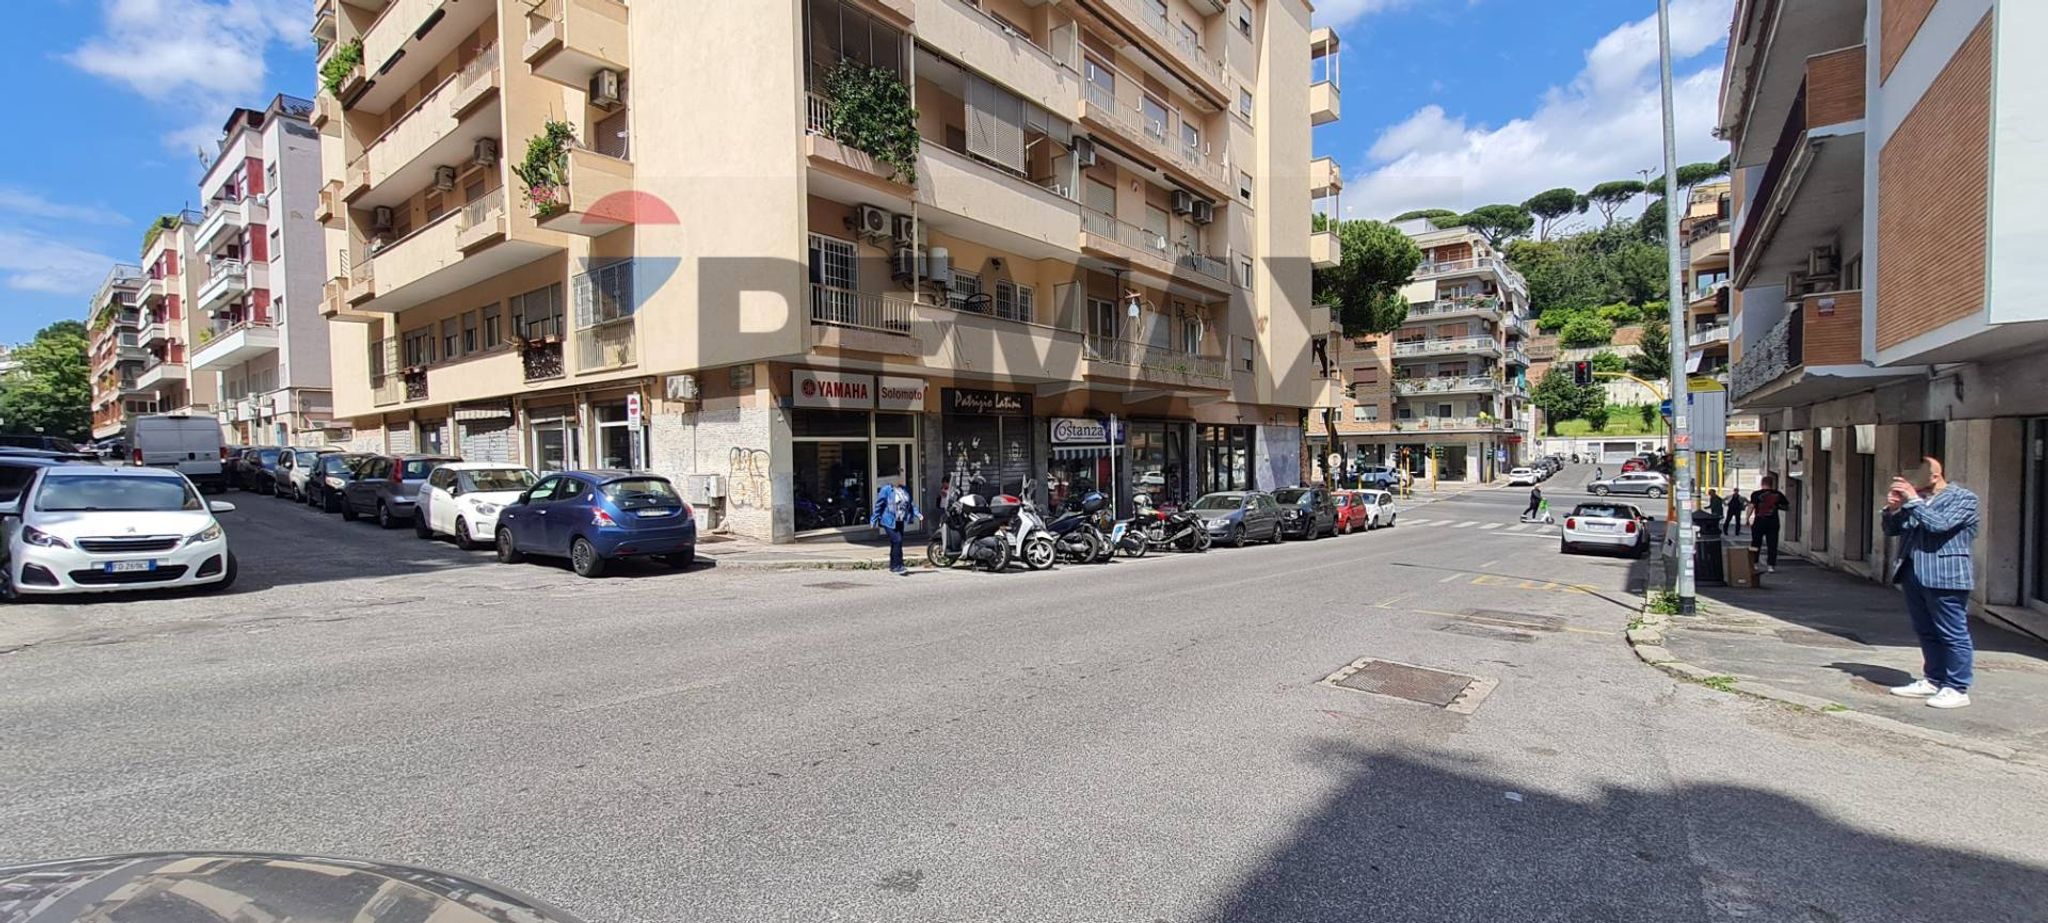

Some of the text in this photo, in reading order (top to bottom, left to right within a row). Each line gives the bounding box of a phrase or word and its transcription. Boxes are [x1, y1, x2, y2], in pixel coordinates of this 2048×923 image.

[817, 381, 868, 399] YAMAHA
[881, 387, 923, 400] Solomoto
[954, 390, 1021, 413] Patrizio Latini
[1053, 420, 1104, 441] Costanza
